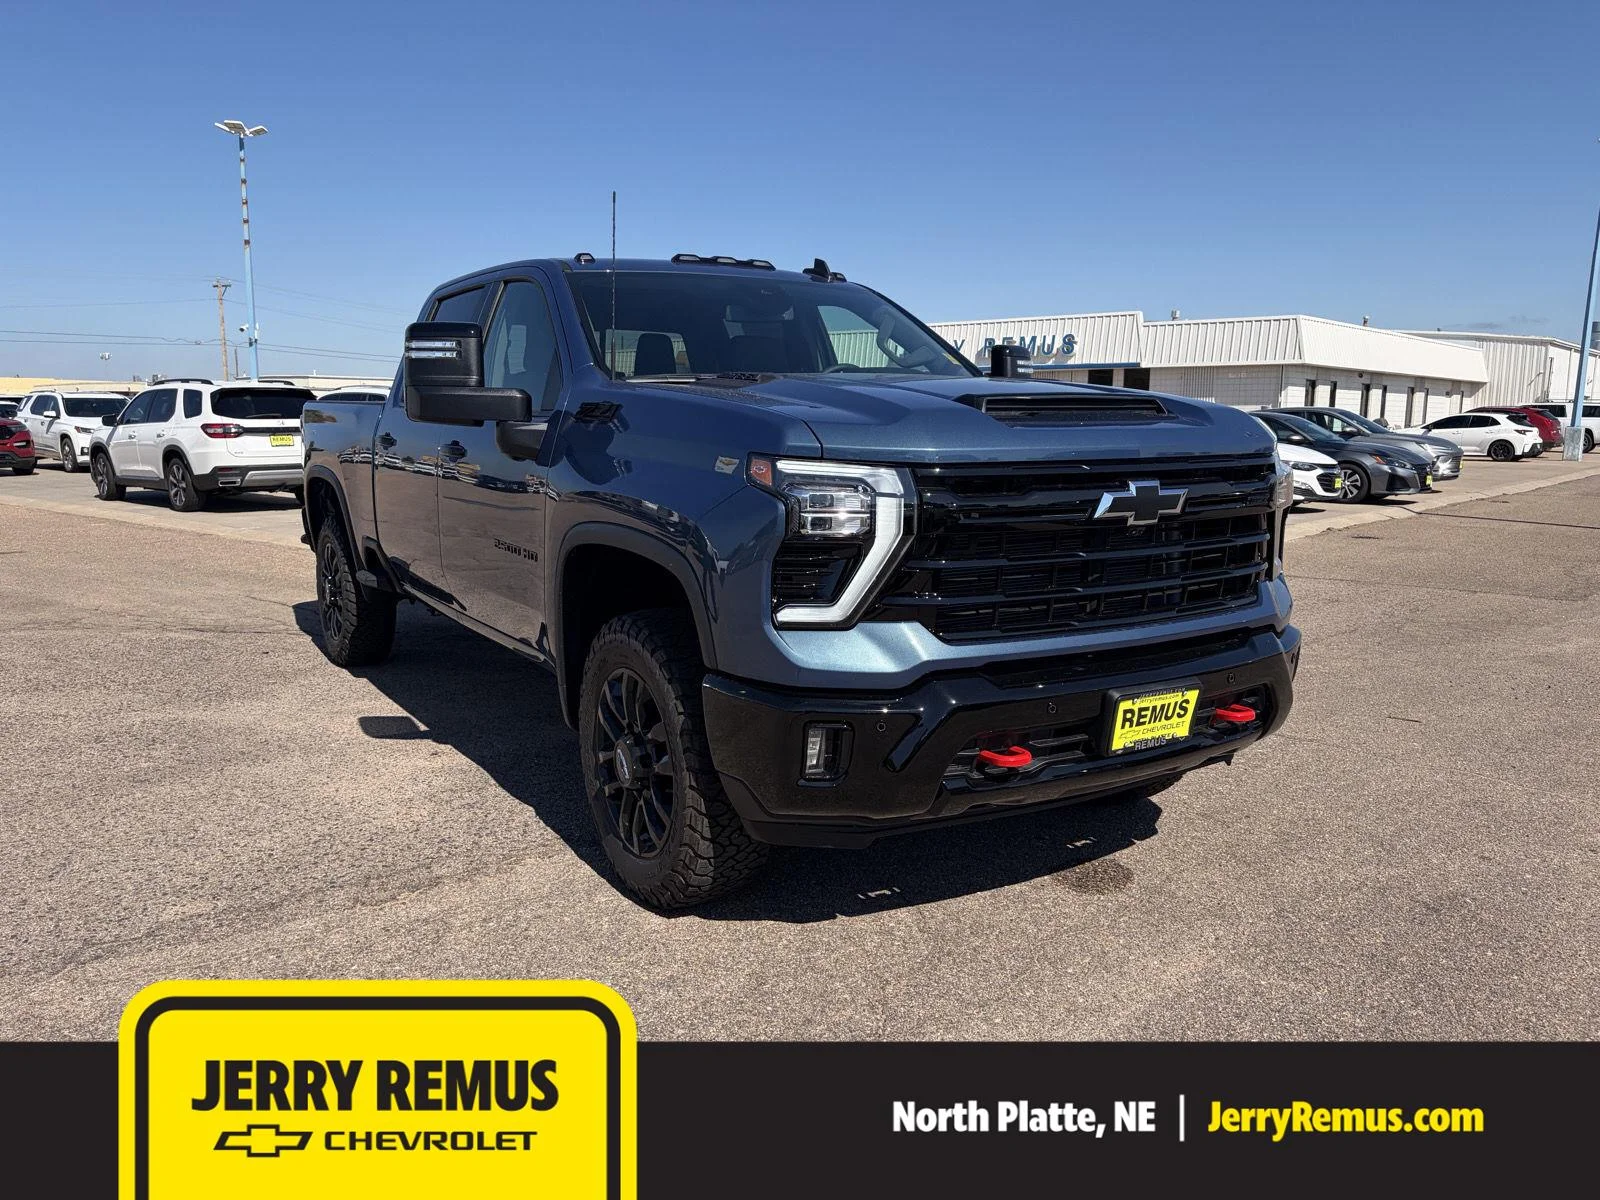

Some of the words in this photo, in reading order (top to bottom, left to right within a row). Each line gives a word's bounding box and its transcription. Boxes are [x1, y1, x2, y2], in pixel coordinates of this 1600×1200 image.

[1120, 698, 1190, 729] REMUS
[1141, 721, 1186, 735] CHEVROLET
[1135, 737, 1167, 751] REMUS
